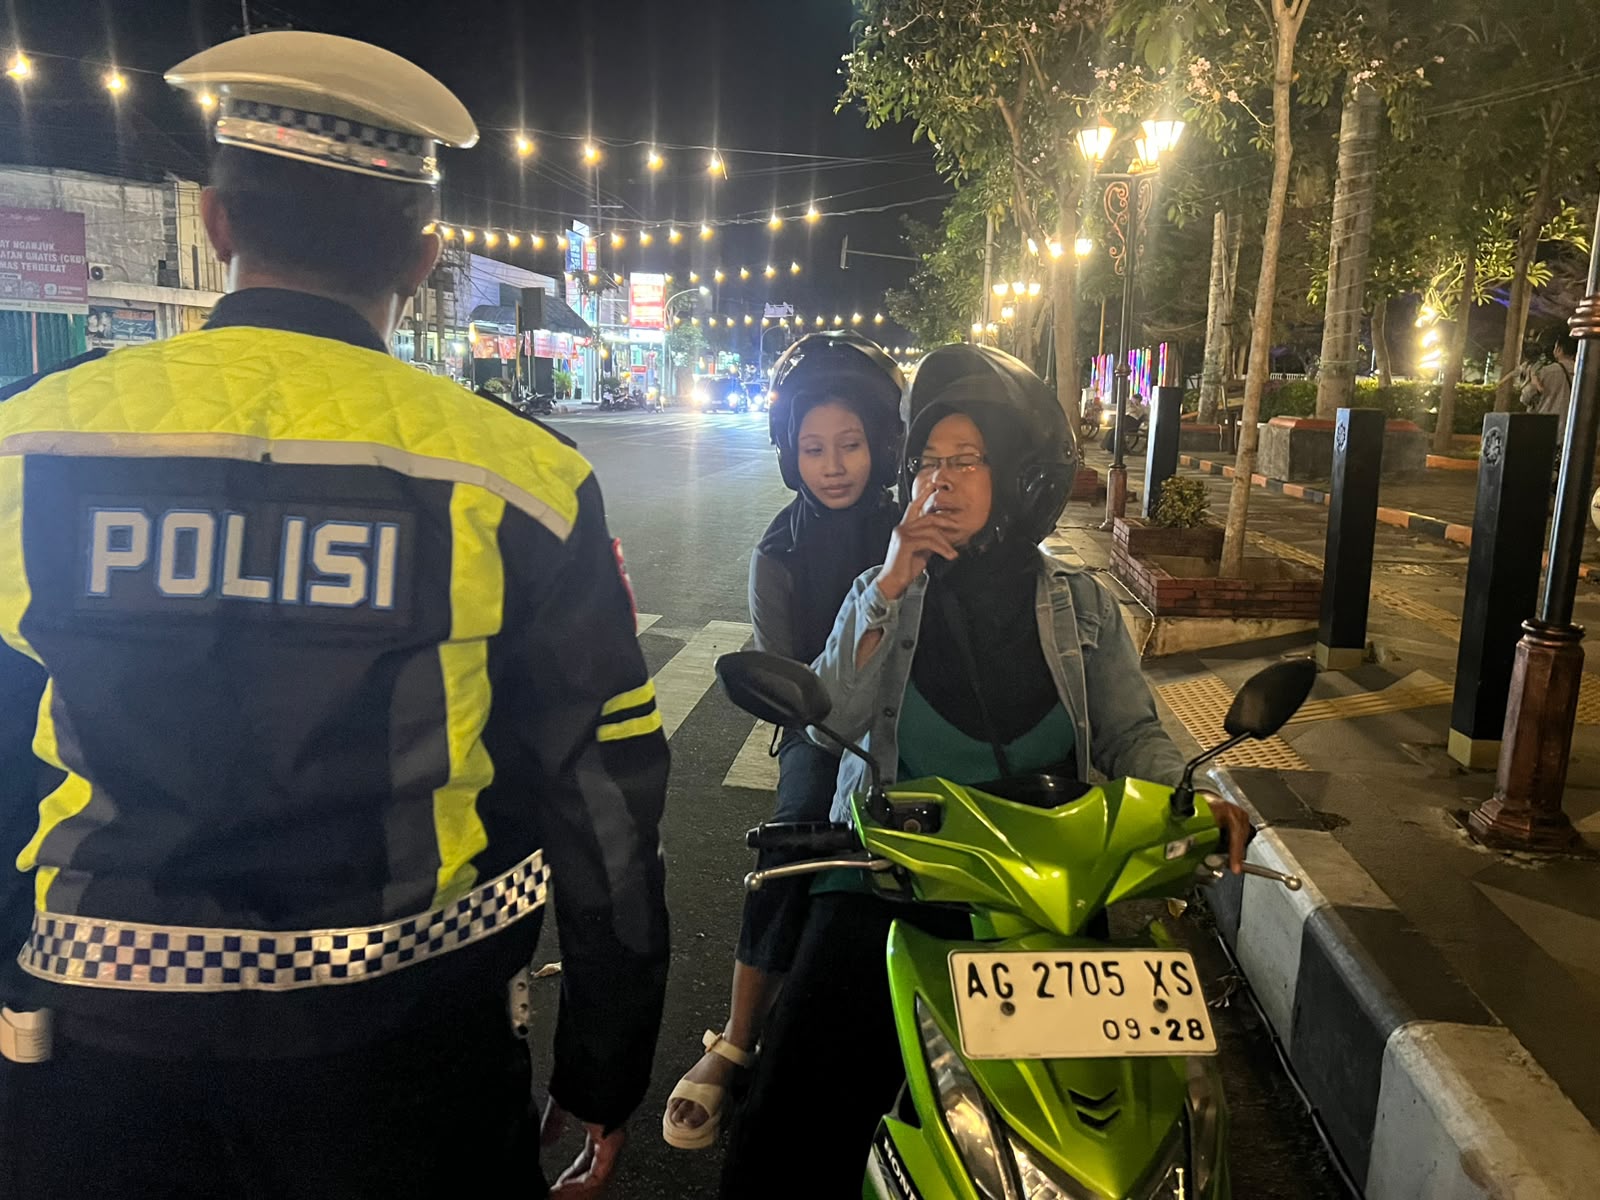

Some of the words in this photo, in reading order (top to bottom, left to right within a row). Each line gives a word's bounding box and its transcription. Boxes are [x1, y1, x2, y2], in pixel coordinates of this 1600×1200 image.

[13, 241, 55, 251] NGANJUK
[88, 509, 398, 608] POLISI
[967, 961, 1014, 999] AG
[1032, 961, 1125, 997] 2705
[1143, 960, 1193, 997] XS
